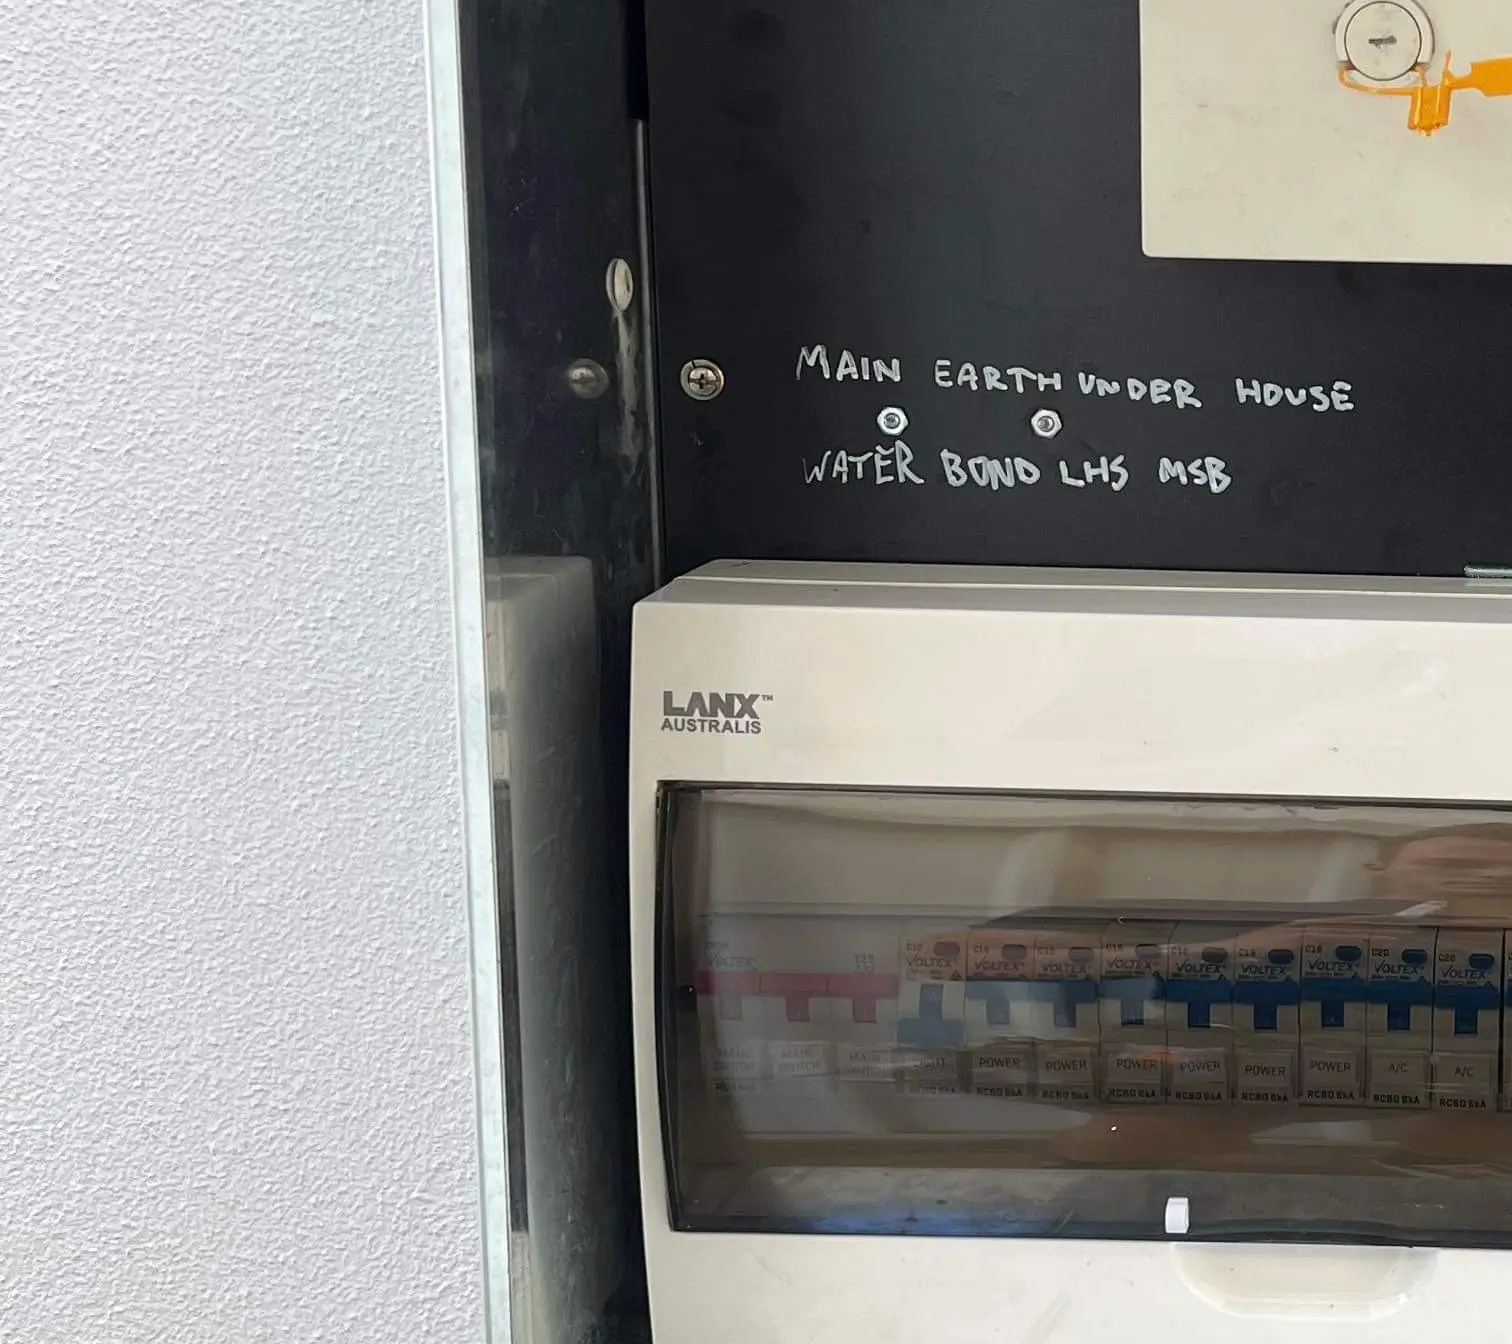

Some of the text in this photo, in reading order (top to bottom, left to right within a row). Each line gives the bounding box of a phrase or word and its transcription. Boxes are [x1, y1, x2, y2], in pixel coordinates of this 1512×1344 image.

[795, 344, 1354, 412] MAIN EARTH UNDER HOUSE
[800, 440, 1232, 494] WATER BOND LHS MSB
[660, 718, 762, 734] AUSTRALIS
[978, 1056, 1020, 1068] POWER
[1045, 1060, 1088, 1071] POWER
[1116, 1058, 1158, 1070] POWER
[1180, 1060, 1222, 1072] POWER
[1310, 1060, 1351, 1072] POWER
[1244, 1064, 1286, 1078] POWER
